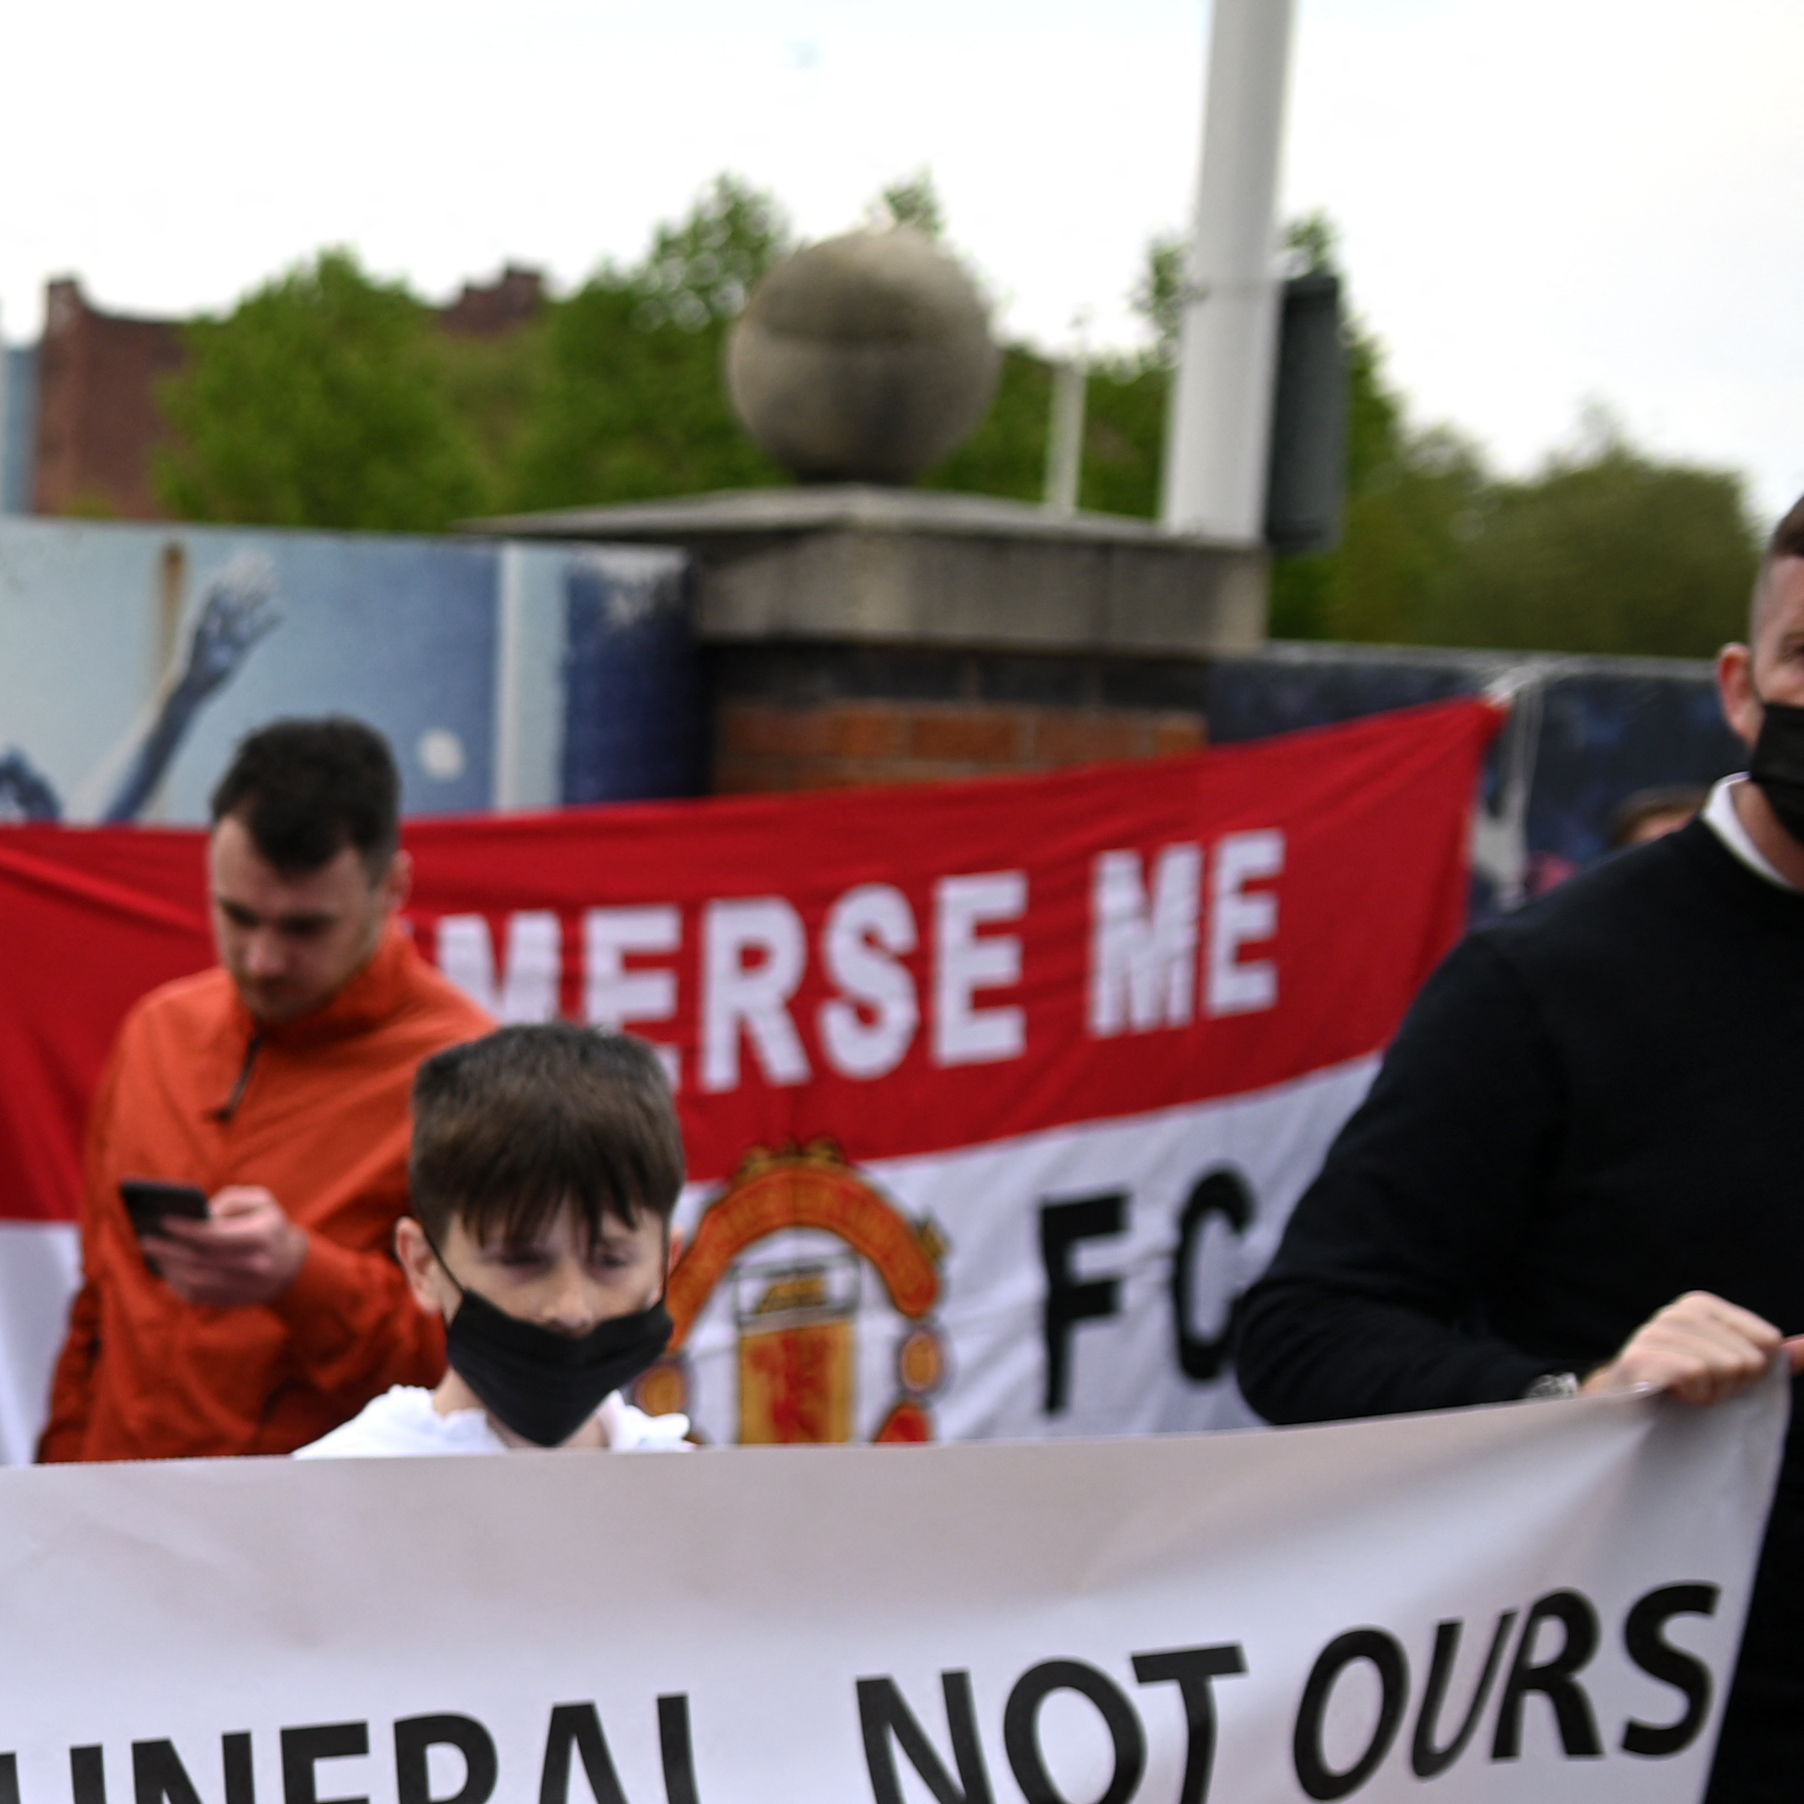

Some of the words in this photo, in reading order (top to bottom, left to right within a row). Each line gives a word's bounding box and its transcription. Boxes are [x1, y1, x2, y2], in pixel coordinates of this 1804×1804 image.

[402, 868, 1028, 1092] MERSE
[1085, 828, 1286, 1039] ME
[1291, 1582, 1721, 1804] OURS
